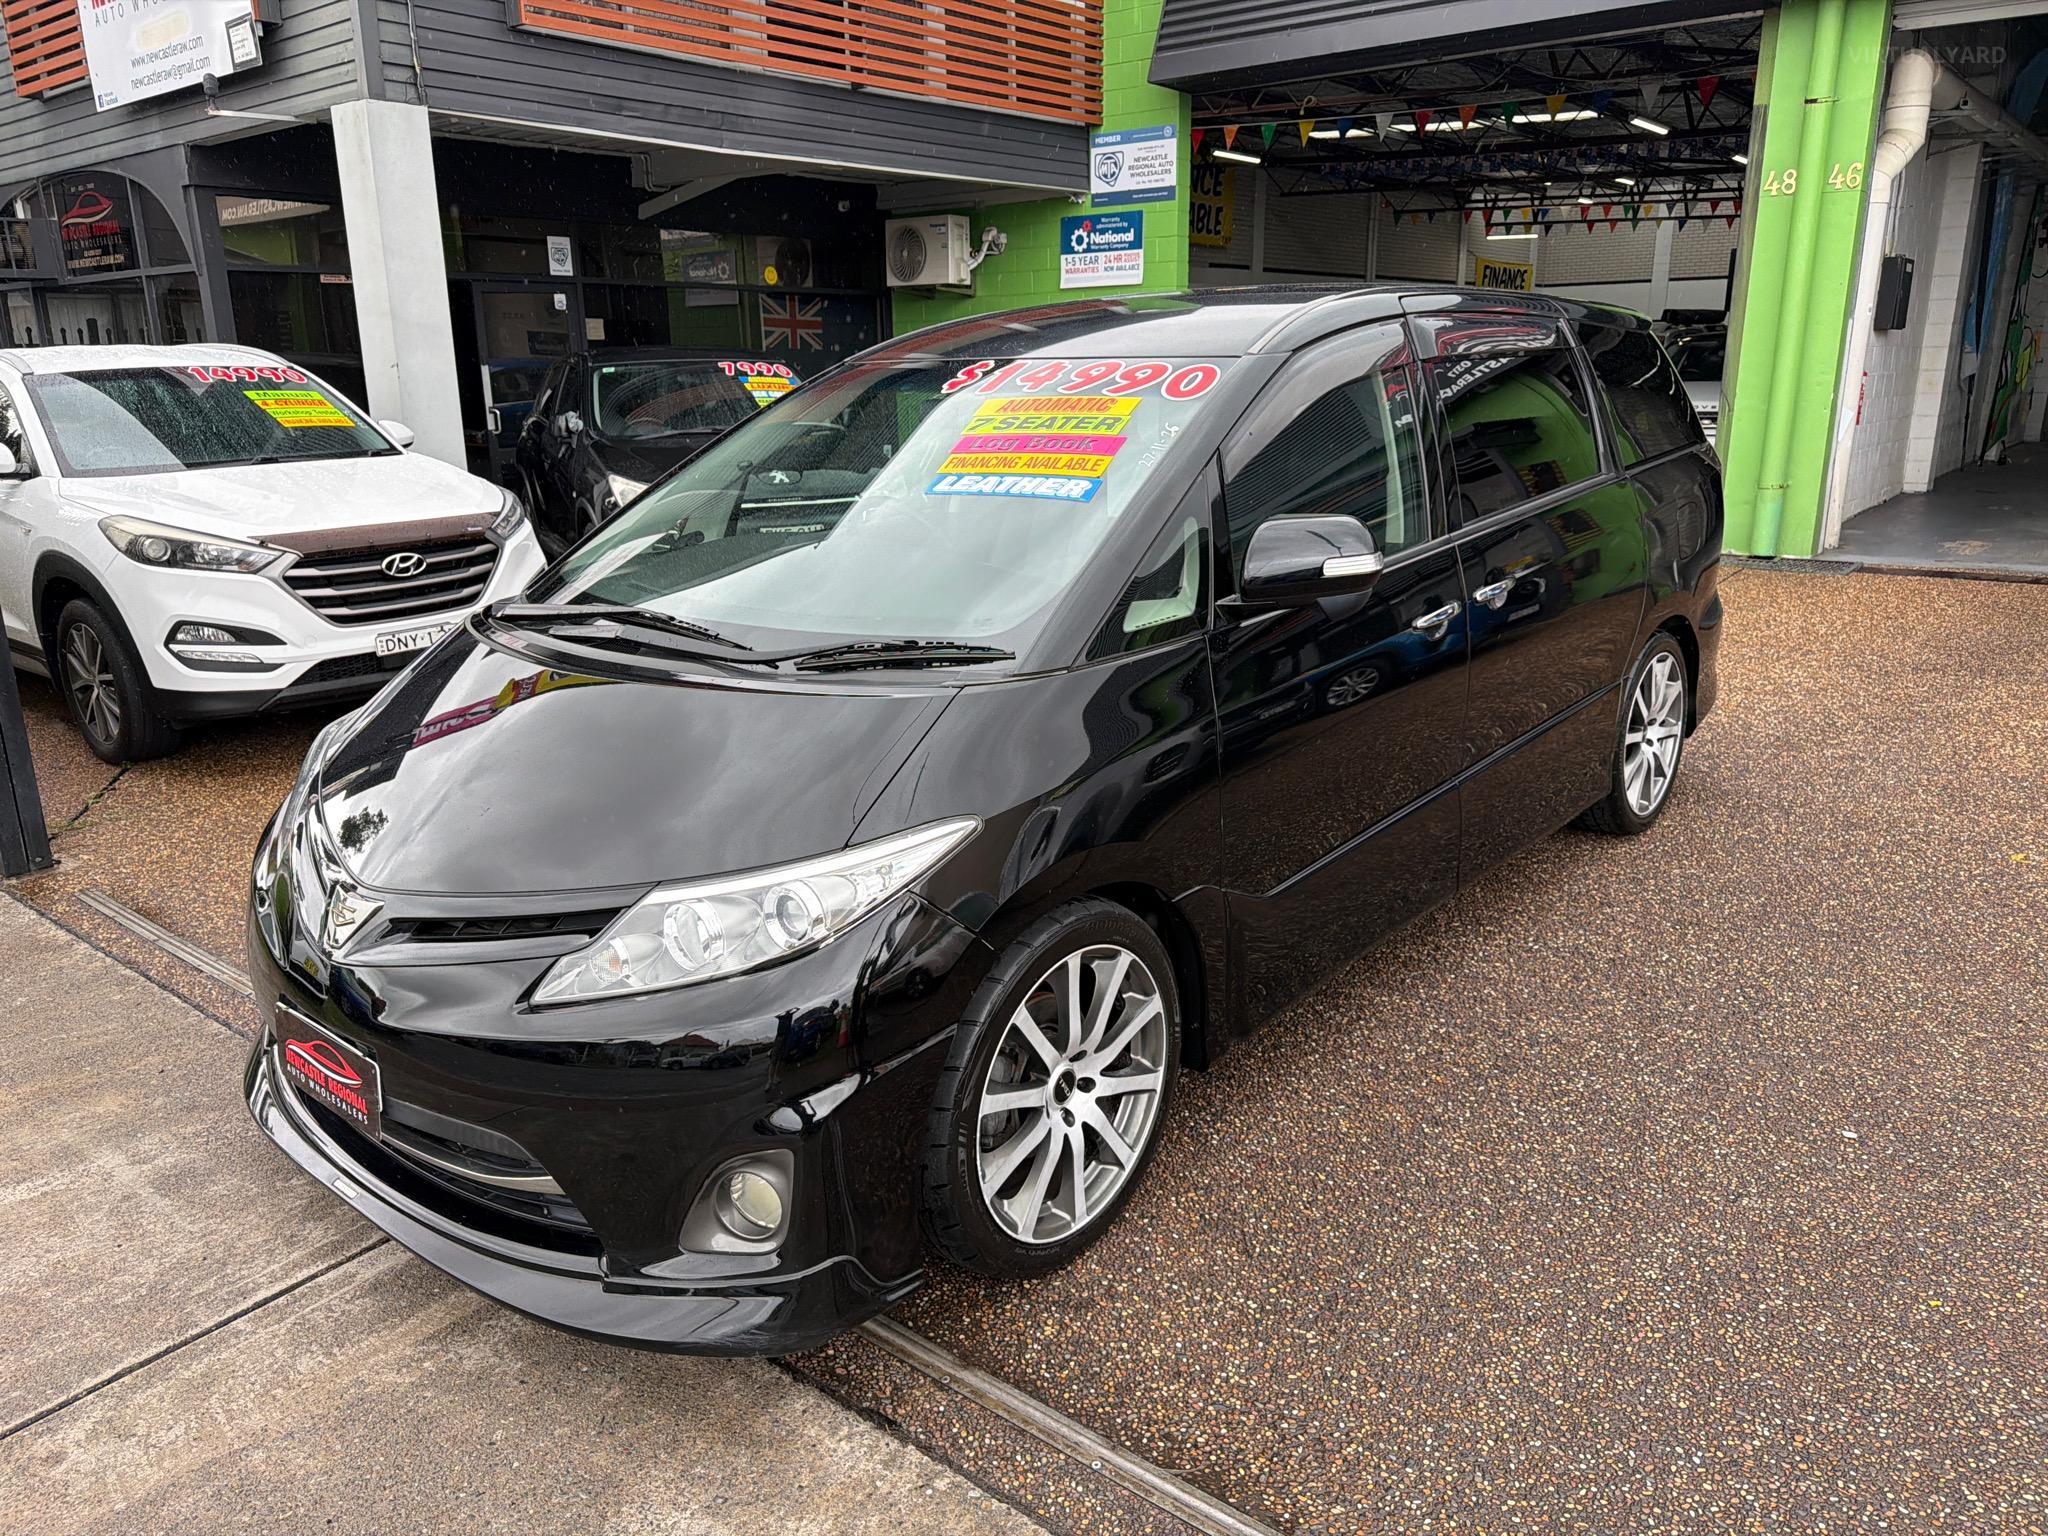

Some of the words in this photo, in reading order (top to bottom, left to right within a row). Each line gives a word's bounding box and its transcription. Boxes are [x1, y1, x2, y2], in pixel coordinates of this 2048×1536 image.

[95, 3, 124, 27] AUTO
[131, 35, 204, 68] www.newcastleraw.com
[131, 55, 211, 90] newcastleraw@gmail.com
[1128, 162, 1157, 171] REGIONAL
[1158, 160, 1174, 168] AUTO
[1134, 153, 1168, 163] NEWCASTLE
[1129, 168, 1172, 178] WHOLESALERS
[1829, 162, 1864, 190] 46
[1763, 169, 1797, 196] 48
[1090, 228, 1134, 244] National
[1064, 257, 1076, 267] 1-5
[1078, 255, 1100, 266] YEAR
[1104, 255, 1112, 265] 24
[1113, 254, 1123, 264] HR
[1065, 266, 1100, 275] WARRANTIES
[1482, 264, 1528, 290] FINANCE
[188, 366, 307, 383] 14990
[718, 361, 793, 377] 7990
[941, 360, 1221, 400] $14990
[255, 391, 314, 399] Manual
[996, 397, 1117, 413] AUTOMATIC
[968, 416, 988, 433] 7
[999, 416, 1123, 432] SEATER
[968, 436, 1017, 451] Log
[1025, 436, 1095, 451] Book
[945, 456, 1021, 470] FINANCING
[1022, 457, 1105, 472] AVAILABLE
[931, 475, 1093, 499] LEATHER
[287, 1061, 306, 1083] AUTO
[309, 1079, 368, 1125] WHOLESALERS
[328, 1077, 368, 1115] REGIONAL
